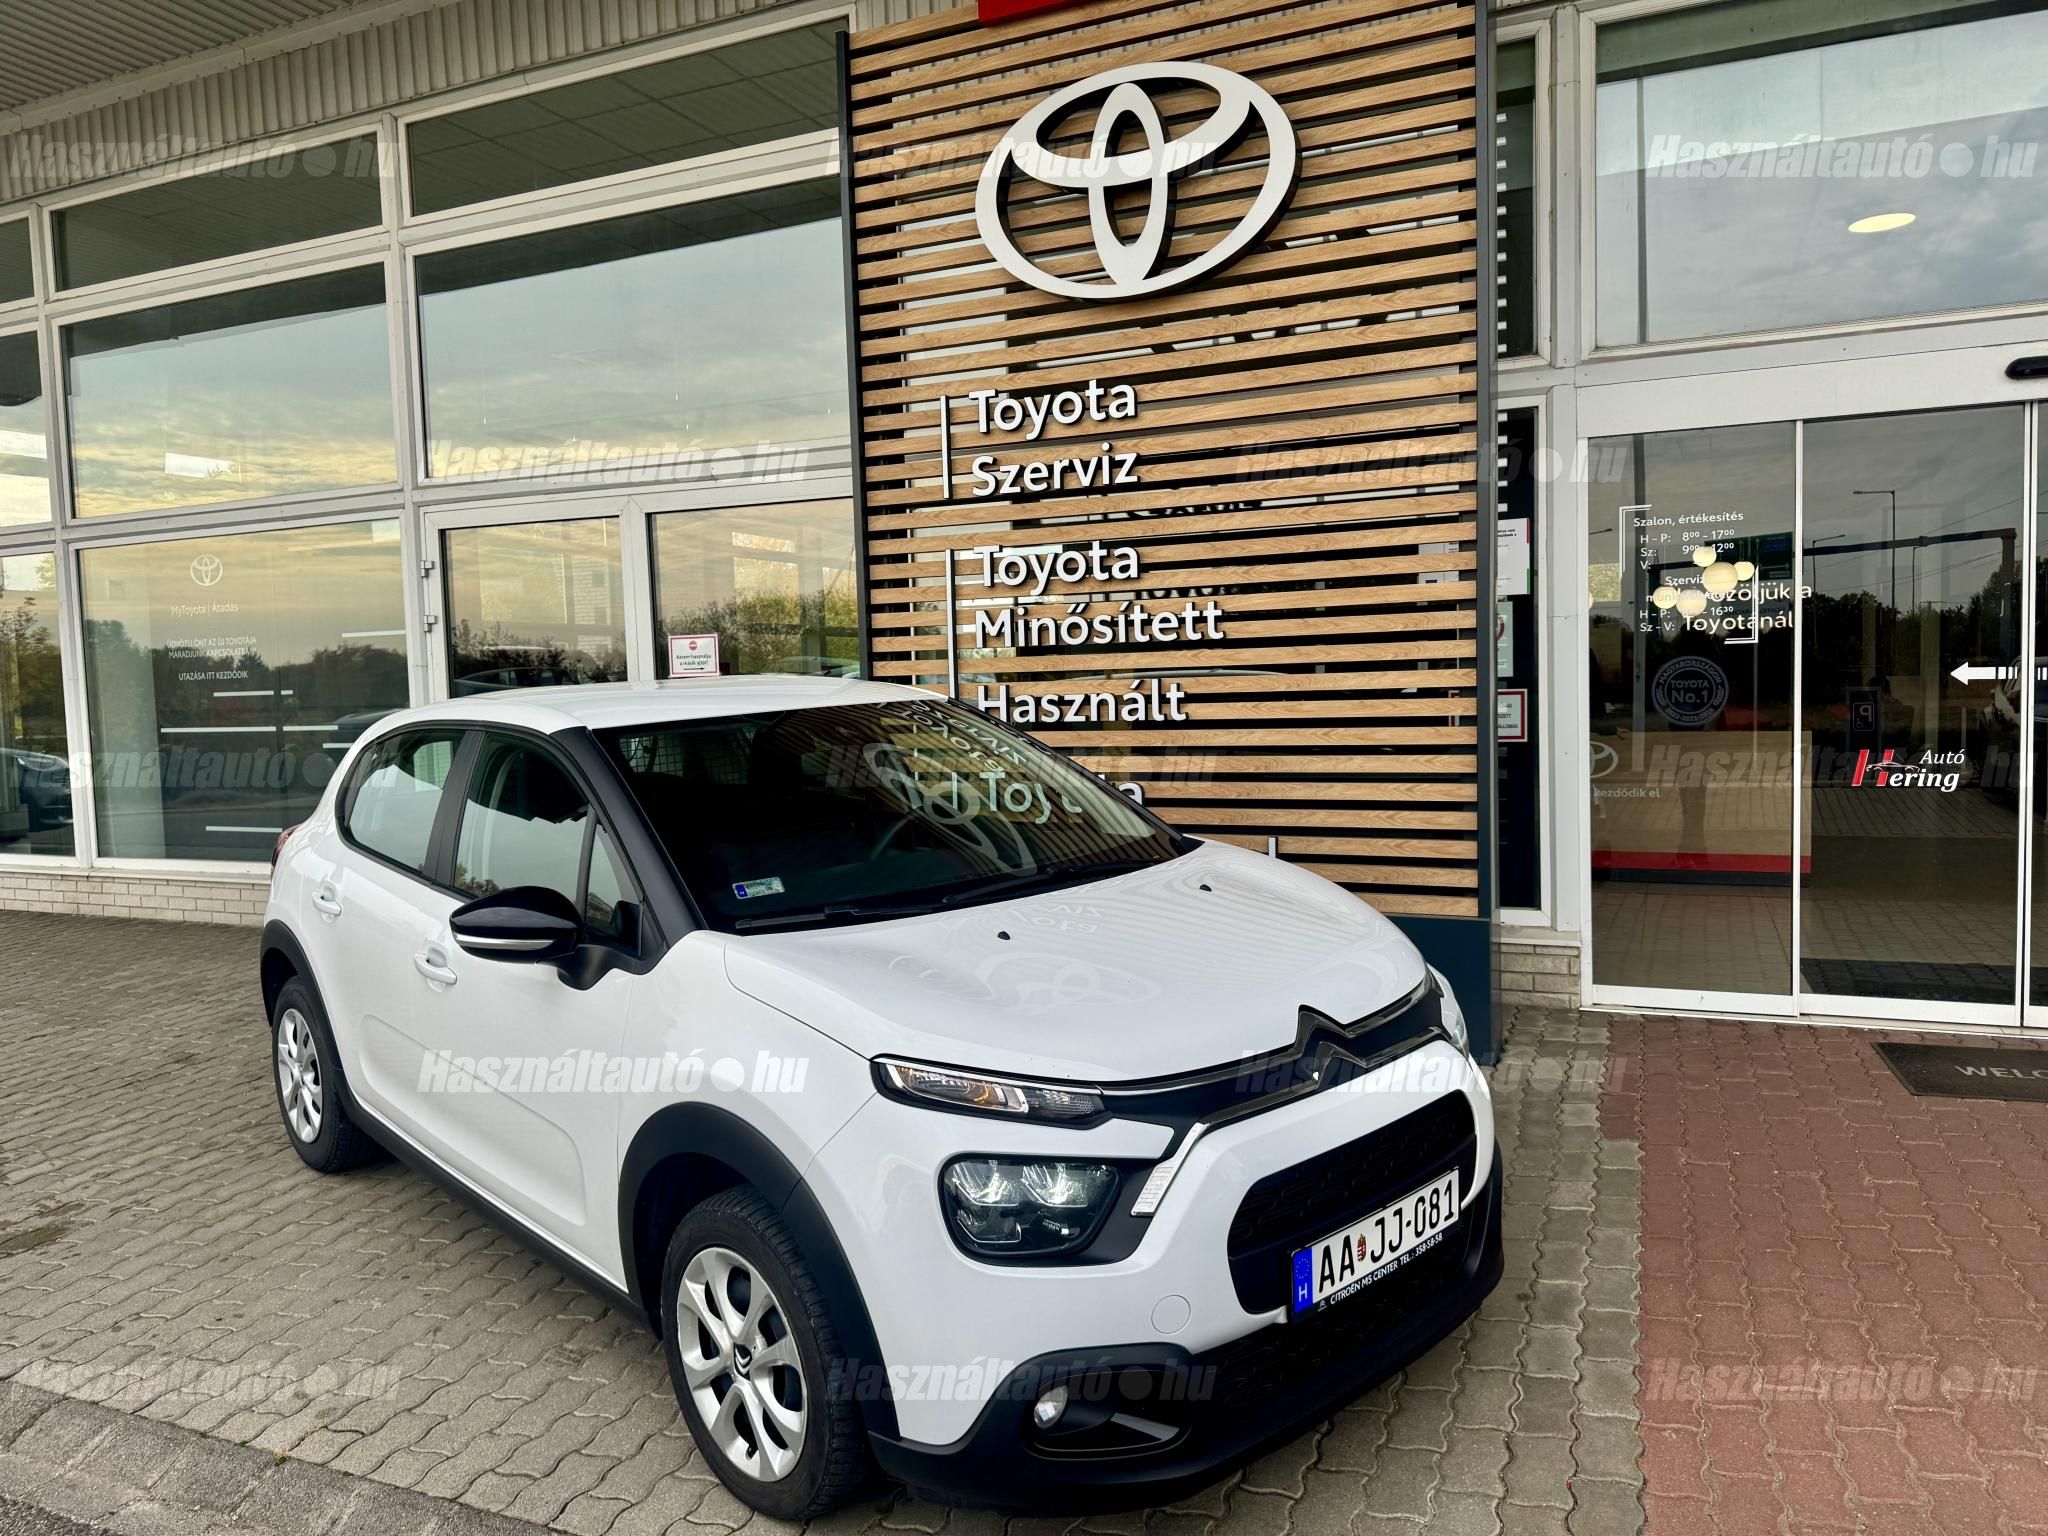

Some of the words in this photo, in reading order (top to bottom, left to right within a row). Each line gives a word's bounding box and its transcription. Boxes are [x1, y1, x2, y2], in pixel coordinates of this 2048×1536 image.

[969, 380, 1138, 440] Toyota
[971, 442, 1140, 498] Szerviz
[1633, 517, 1675, 527] Szalon,
[1679, 511, 1744, 525] értékesítés
[974, 540, 1140, 596] Toyota
[974, 600, 1225, 649] Minősített
[977, 679, 1189, 724] Használt
[1670, 680, 1710, 688] TOYOTA
[1919, 749, 1965, 765] Autó
[1319, 1234, 1355, 1293] AA
[1373, 1261, 1398, 1281] CENTER
